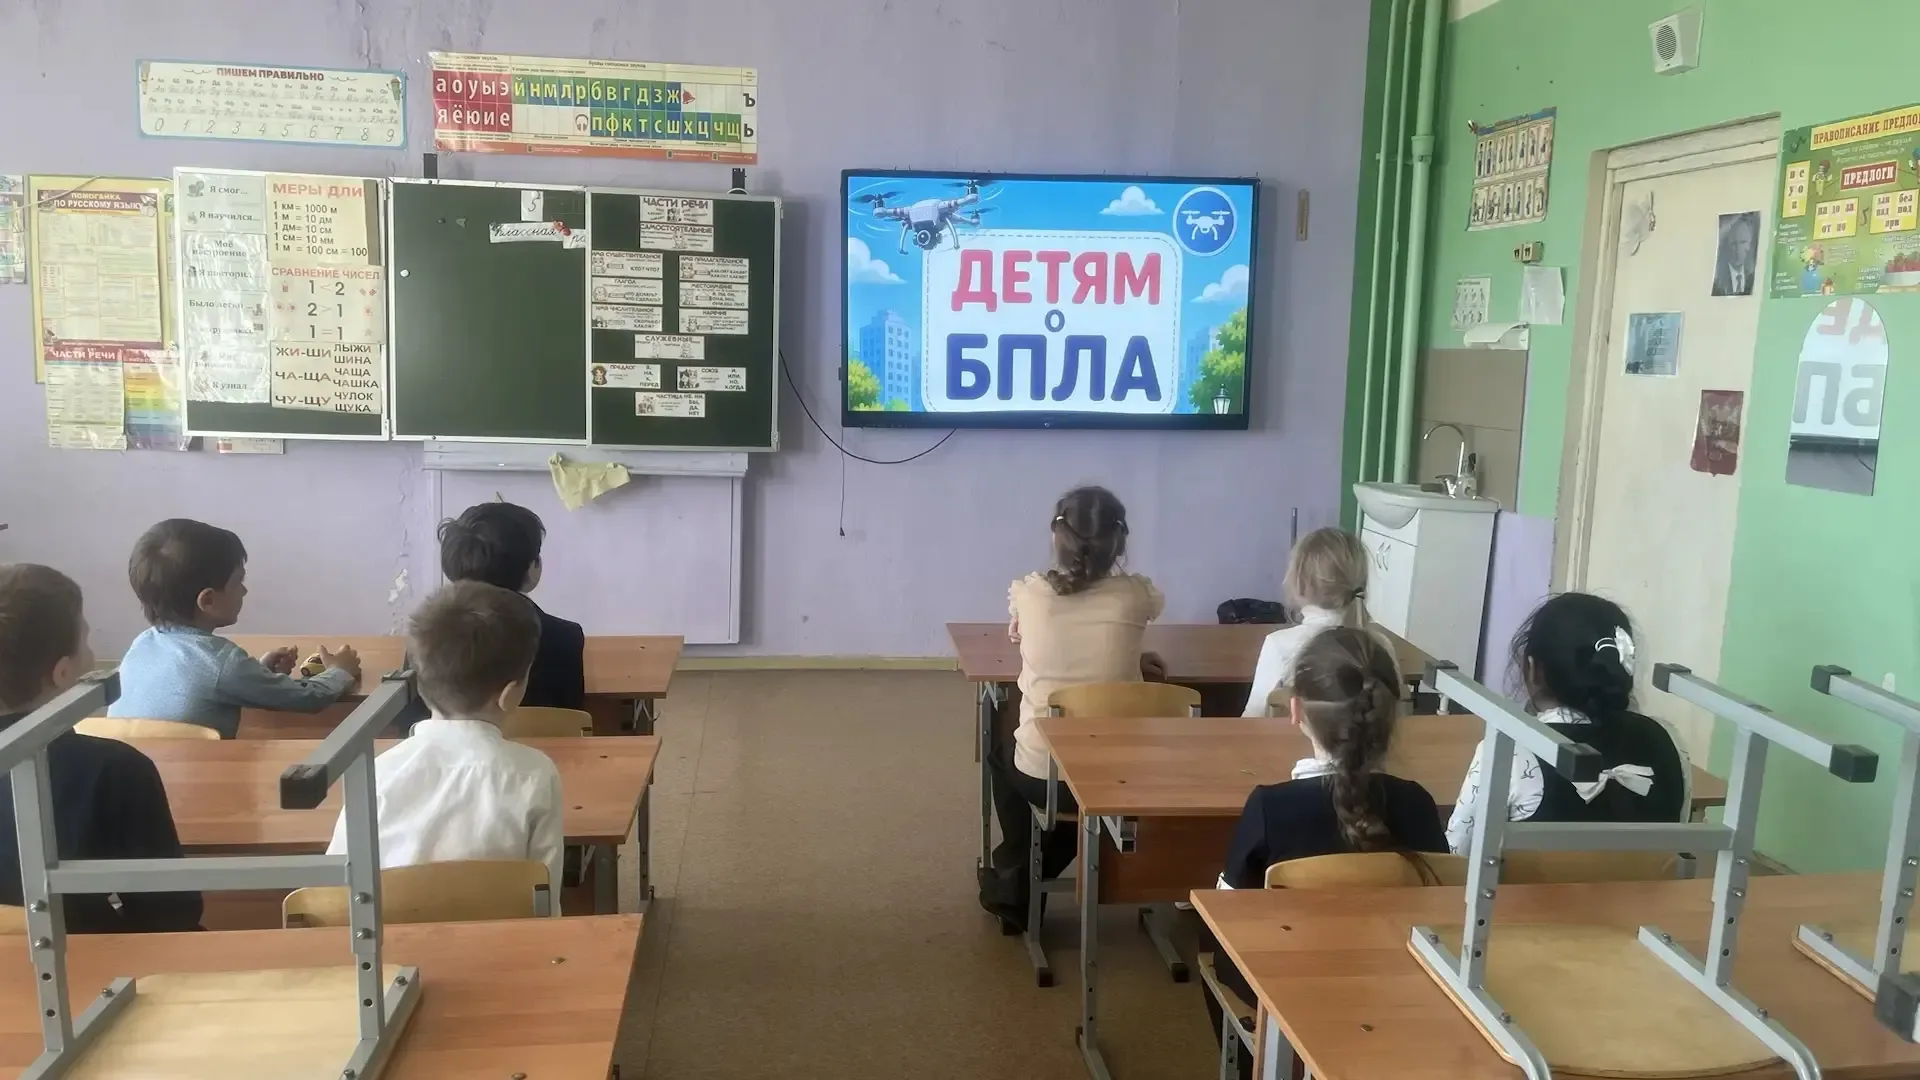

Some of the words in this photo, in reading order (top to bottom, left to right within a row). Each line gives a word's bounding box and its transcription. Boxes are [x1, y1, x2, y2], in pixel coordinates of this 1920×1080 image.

[217, 68, 257, 77] ПИШЕМ
[259, 70, 324, 81] ПРАВИЛЬНО
[155, 118, 164, 131] 0
[183, 120, 190, 131] 1
[206, 120, 215, 133] 2
[232, 121, 241, 134] 3
[258, 121, 266, 135] 4
[281, 123, 292, 136] 5
[310, 125, 317, 138] 6
[334, 126, 343, 139] 7
[361, 128, 369, 141] 8
[386, 129, 395, 142] 9
[1813, 121, 1880, 144] ПРАВОПИСАНИЕ
[1843, 166, 1894, 186] ПРЕДЛОГИ
[273, 183, 322, 196] МЕРЫ
[328, 185, 362, 198] ДЛИ
[54, 200, 65, 208] ПО
[68, 199, 111, 209] РУССКОМУ
[273, 201, 277, 209] 1
[305, 204, 327, 213] 1000
[643, 197, 678, 207] ЧАСТИ
[681, 199, 708, 209] РЕЧИ
[274, 211, 277, 220] 1
[306, 214, 316, 223] 10
[274, 222, 278, 230] 1
[306, 225, 316, 233] 10
[641, 224, 712, 233] САМОСТОЯТЕЛЬНЫЕ
[274, 232, 278, 240] 1
[306, 235, 317, 243] 10
[275, 243, 279, 251] 1
[306, 246, 323, 254] 100
[351, 247, 367, 256] 100
[271, 267, 340, 278] СРАВНЕНИЕ
[342, 270, 380, 280] ЧИСЕЛ
[950, 249, 1162, 312] ДЕТЯМ
[309, 280, 314, 294] 1
[335, 281, 345, 295] 2
[190, 299, 214, 307] Было
[307, 302, 317, 316] 2
[337, 303, 342, 317] 1
[310, 325, 315, 338] 1
[338, 326, 343, 340] 1
[276, 347, 331, 358] ЖИ-ШИ
[334, 344, 371, 352] ЛЫЖИ
[53, 350, 86, 359] ЧАСТИ
[88, 352, 116, 360] РЕЧИ
[334, 356, 372, 364] ШИНА
[334, 368, 371, 377] ЧАЩА
[945, 333, 1163, 401] БПЛА
[275, 371, 331, 382] ЧА-ЩА
[333, 379, 379, 388] ЧАШКА
[275, 396, 331, 407] ЧУ-ЩУ
[334, 392, 373, 400] ЧУЛОК
[335, 404, 371, 412] ЩУКА
